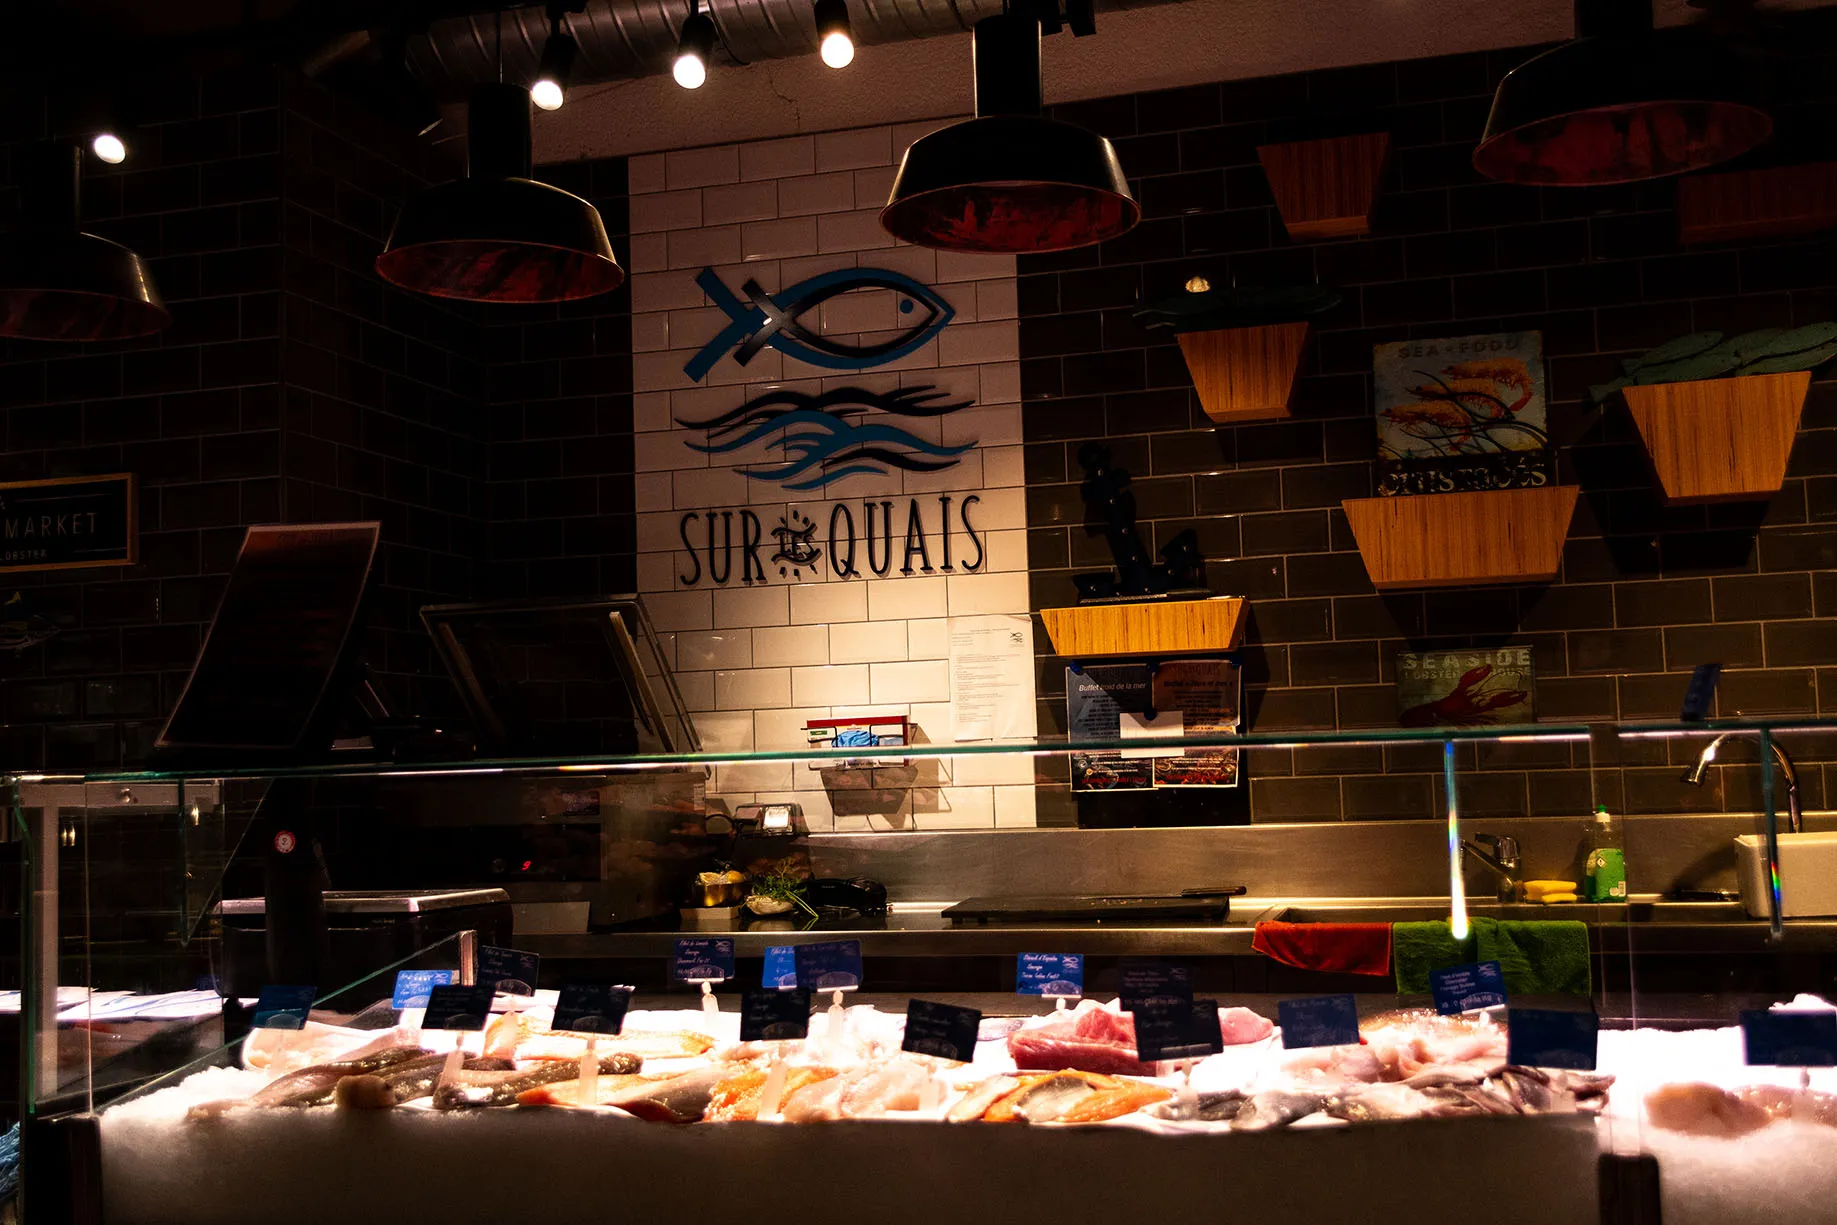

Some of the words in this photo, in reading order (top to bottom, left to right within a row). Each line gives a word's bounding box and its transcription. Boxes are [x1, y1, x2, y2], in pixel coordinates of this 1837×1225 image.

[1398, 346, 1439, 359] SEA
[1460, 338, 1518, 353] FOOD
[4, 510, 98, 539] MARKET
[680, 509, 767, 586] SUR
[779, 531, 817, 559] LES
[828, 495, 985, 579] QUAIS
[1403, 648, 1532, 669] SEASIDE
[1078, 684, 1100, 692] Buffet
